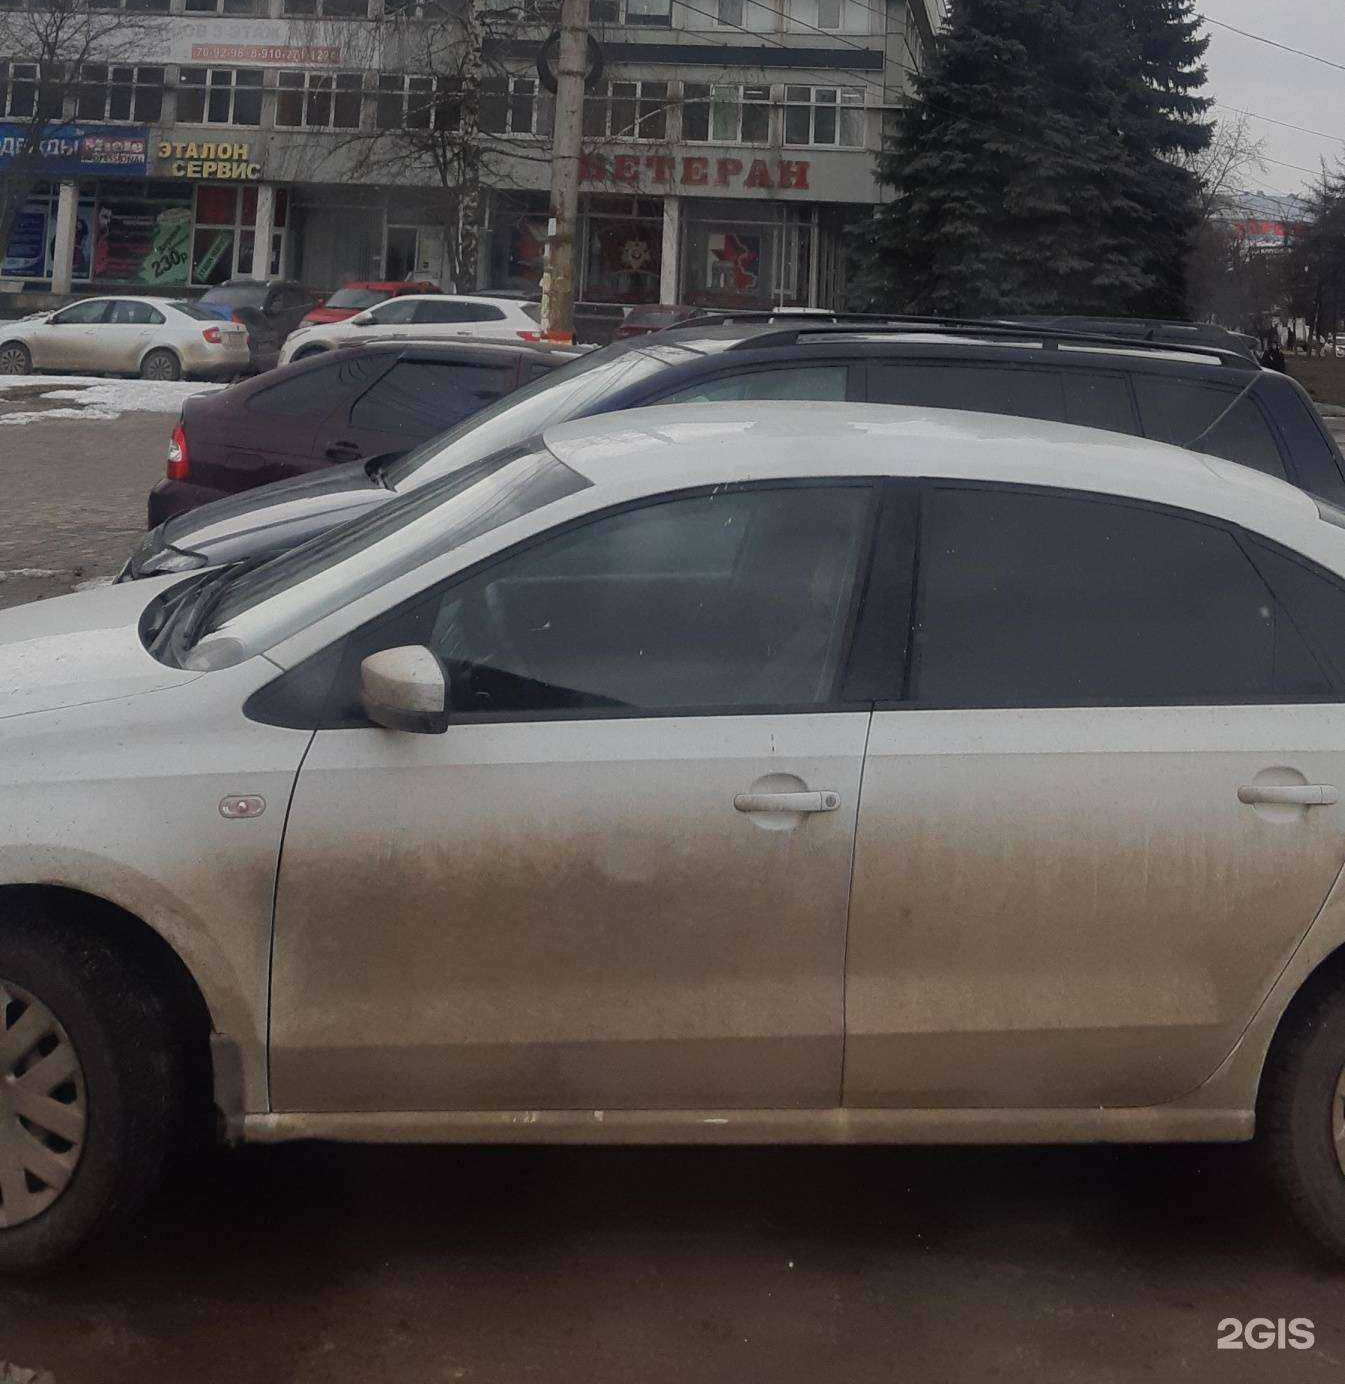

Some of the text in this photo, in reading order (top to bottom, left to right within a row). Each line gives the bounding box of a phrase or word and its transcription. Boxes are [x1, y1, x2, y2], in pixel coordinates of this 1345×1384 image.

[158, 141, 249, 159] ЭТАЛОН
[172, 160, 260, 180] СЕРВИС
[578, 153, 811, 190] ВЕТЕРАН
